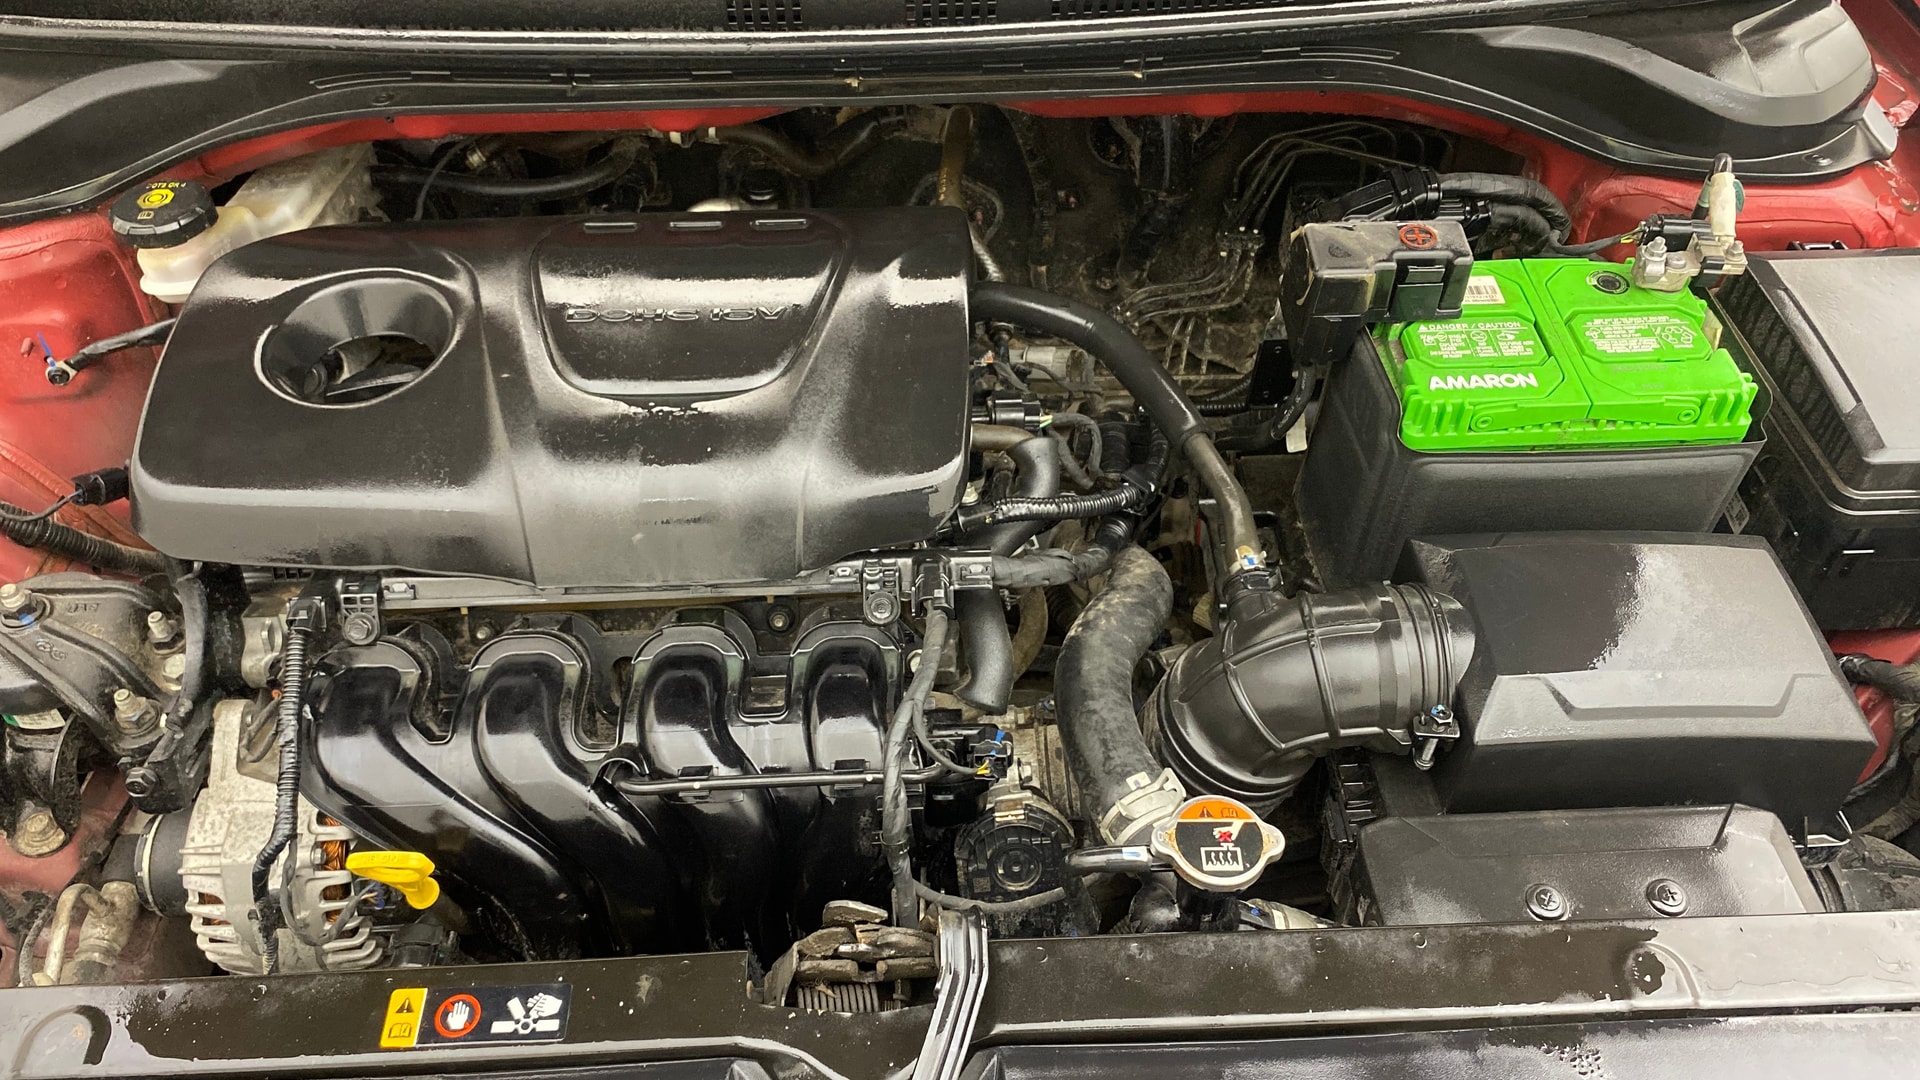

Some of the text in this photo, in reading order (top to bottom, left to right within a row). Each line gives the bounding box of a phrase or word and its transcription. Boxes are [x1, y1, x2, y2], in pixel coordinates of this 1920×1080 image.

[710, 306, 787, 321] 16V
[1428, 323, 1468, 331] DANGER
[1477, 321, 1520, 330] CAUTION
[1429, 372, 1539, 391] AMARON
